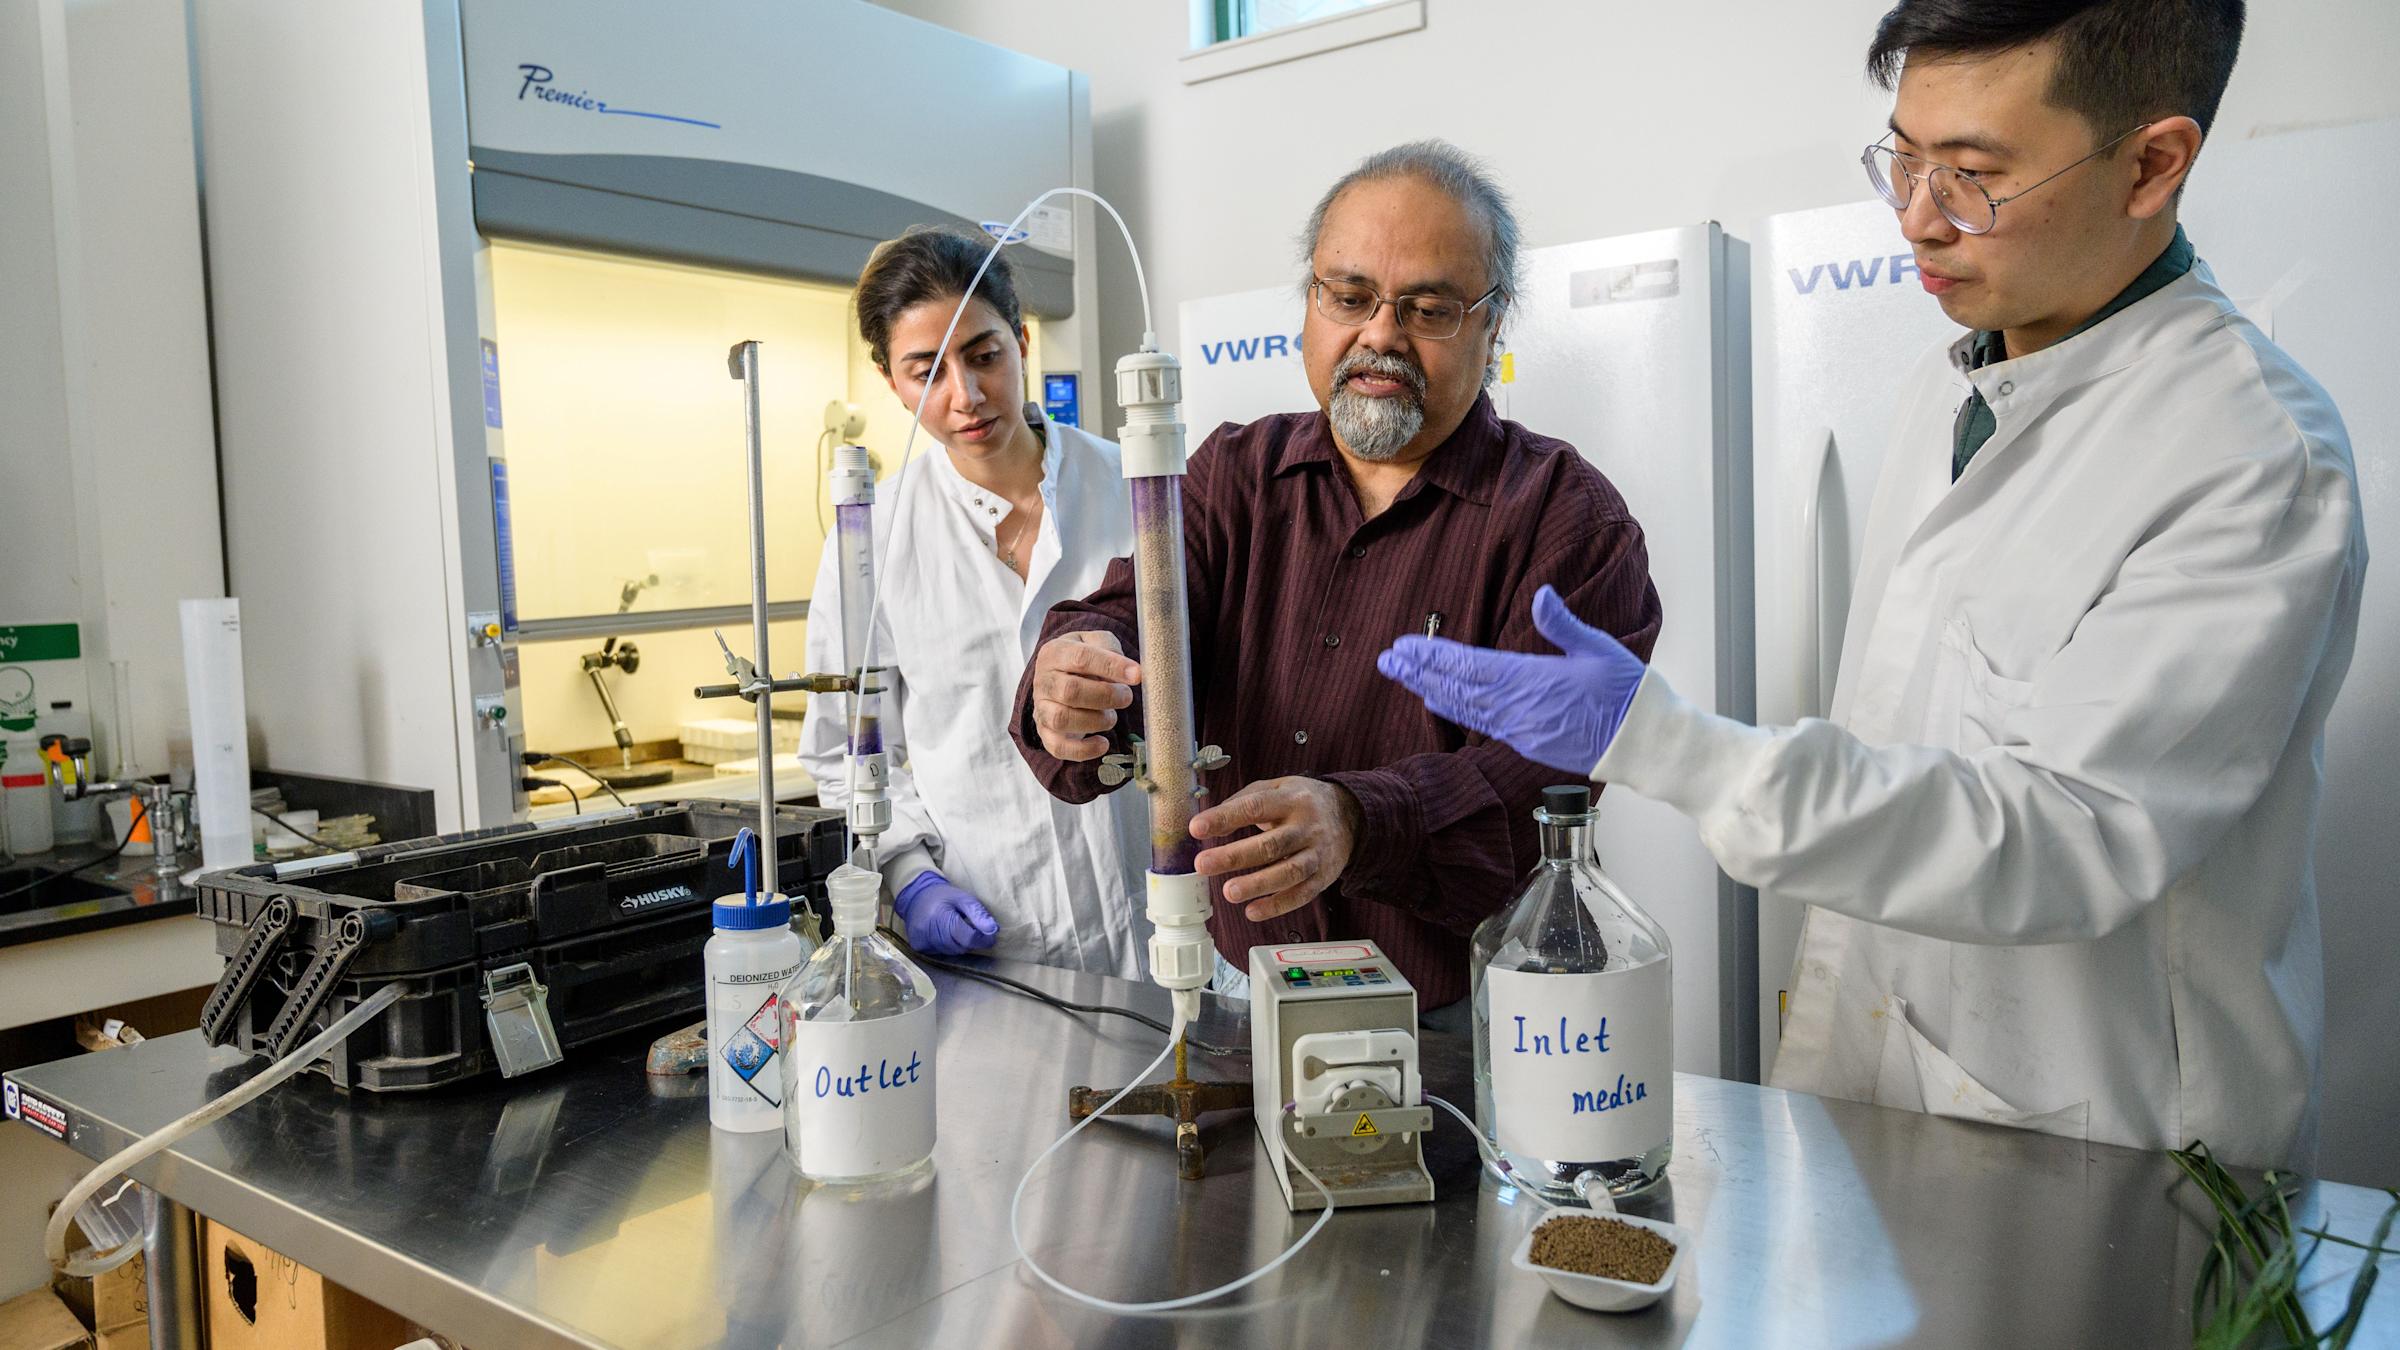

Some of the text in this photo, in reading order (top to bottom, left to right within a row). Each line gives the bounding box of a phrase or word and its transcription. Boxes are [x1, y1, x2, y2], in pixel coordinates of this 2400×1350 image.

[517, 64, 607, 113] Premier
[1788, 252, 1921, 295] VWR
[1200, 334, 1288, 365] VWR
[637, 885, 685, 906] HUSKY
[730, 971, 780, 983] DEIONIZED
[1513, 1016, 1611, 1056] Inlet
[815, 1050, 922, 1099] Outlet
[1572, 1073, 1648, 1115] media
